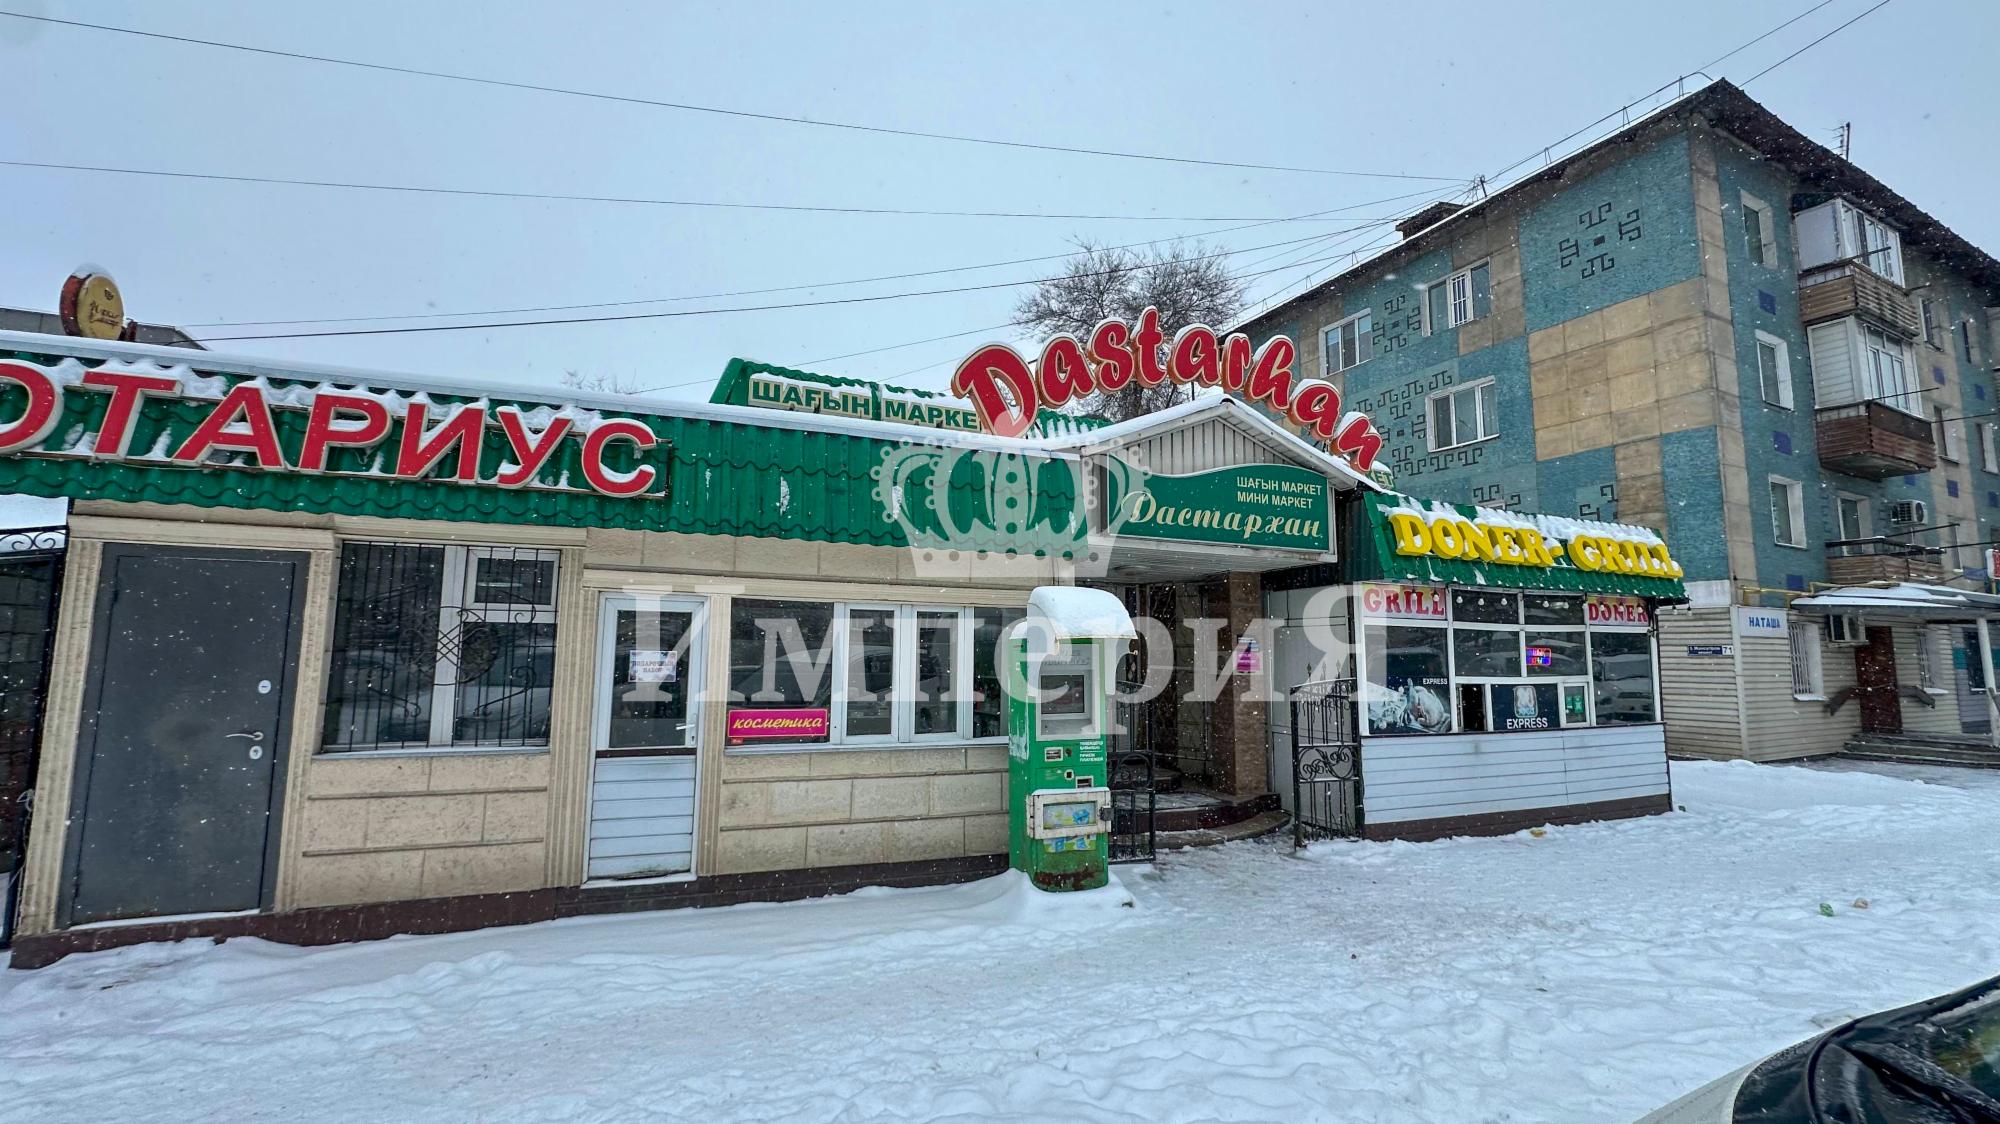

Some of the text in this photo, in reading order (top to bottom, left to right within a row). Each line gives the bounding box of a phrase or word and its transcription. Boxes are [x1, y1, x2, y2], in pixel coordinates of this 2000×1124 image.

[951, 306, 1382, 472] Dastarhan
[752, 381, 982, 432] ШАҒЫН МАРКЕ
[1237, 476, 1322, 496] ШАҒЫН МАРКЕТ
[1237, 491, 1313, 509] МИНИ МАРКЕТ
[1121, 491, 1322, 539] Дастархан
[1363, 587, 1445, 615] GRILL
[1588, 602, 1648, 623] DONER
[1748, 616, 1781, 629] НАТАША
[1722, 646, 1733, 654] 71
[1422, 677, 1448, 685] EXPRESS
[733, 717, 823, 730] косметика
[1506, 716, 1549, 730] EXPRESS
